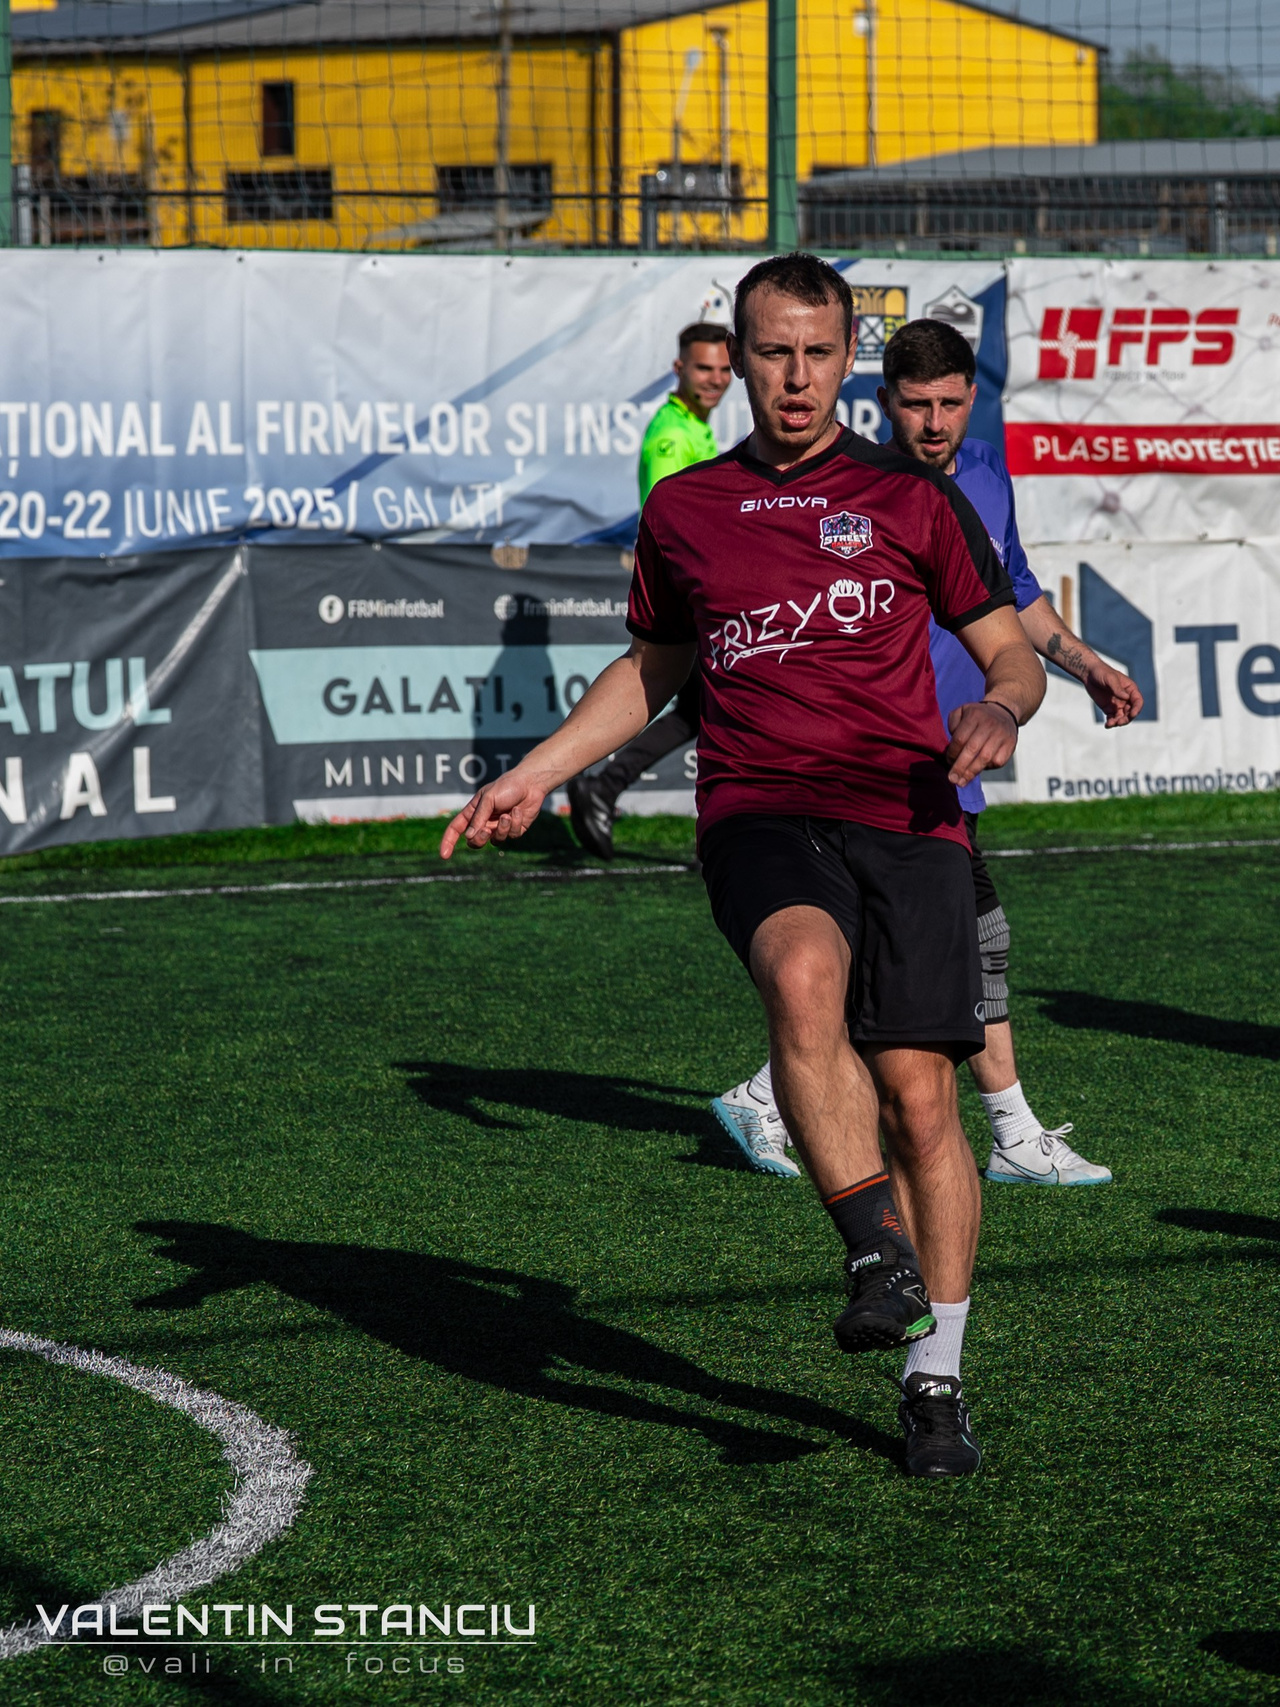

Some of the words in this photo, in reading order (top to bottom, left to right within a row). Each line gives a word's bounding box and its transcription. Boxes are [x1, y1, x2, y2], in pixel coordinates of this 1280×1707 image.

[1107, 308, 1240, 366] FPS
[0, 400, 176, 479] ȚIONAL
[185, 400, 244, 456] AL
[256, 400, 493, 457] FIRMELOR
[504, 401, 548, 475] ȘI
[1033, 435, 1129, 462] PLASE
[0, 489, 112, 539] 20-22
[124, 487, 234, 538] IUNIE
[740, 496, 828, 512] GIVOVA
[823, 533, 867, 546] STREET
[347, 598, 445, 619] FRMinifotbal
[1047, 772, 1140, 798] Panouri
[851, 1252, 881, 1272] Joma
